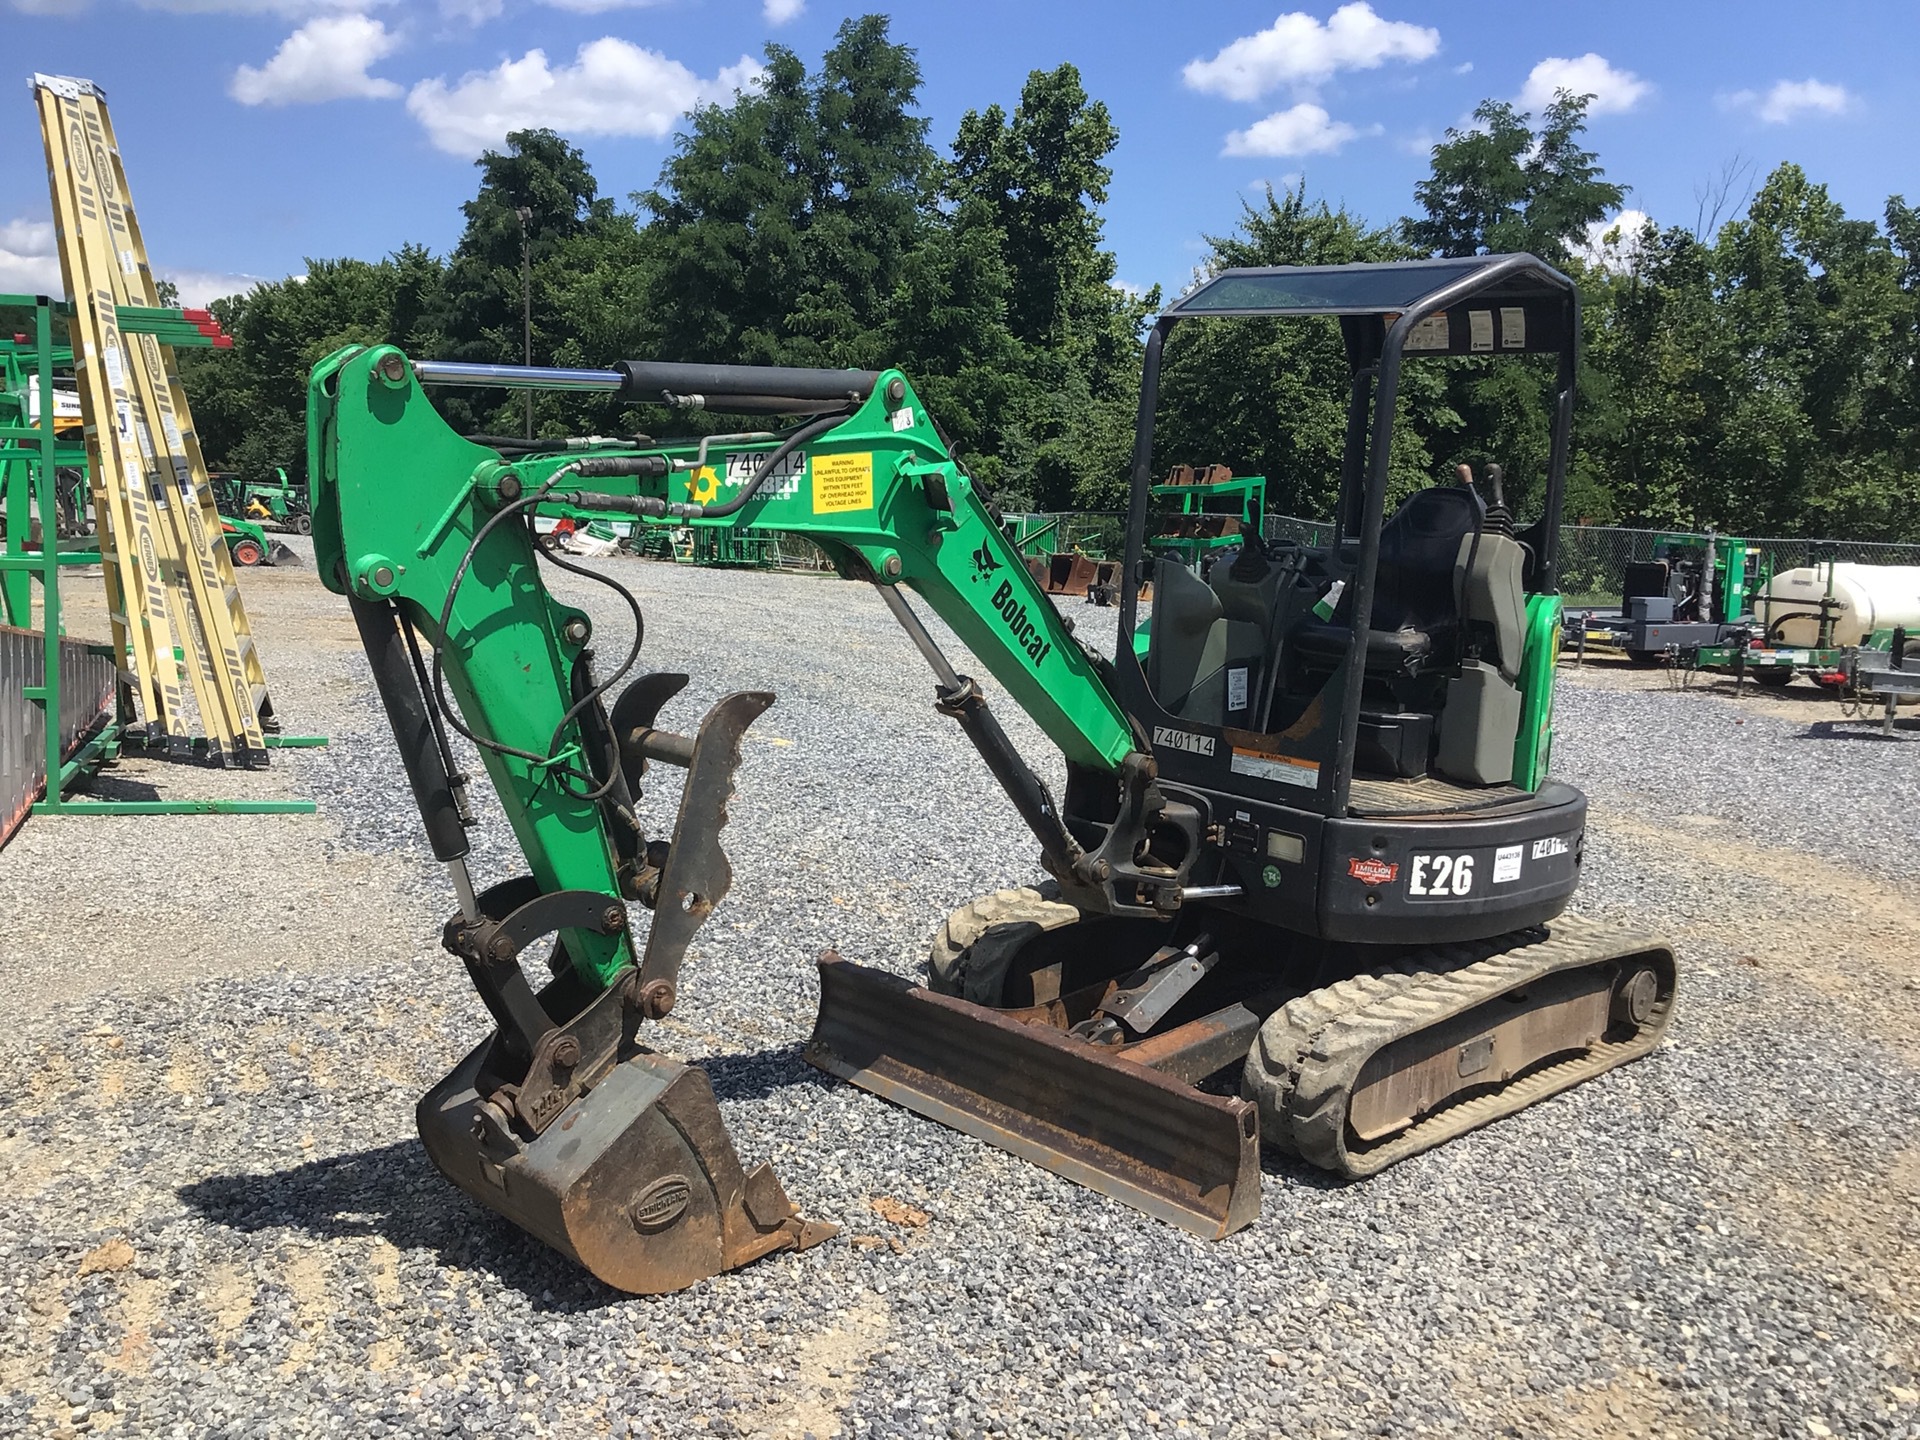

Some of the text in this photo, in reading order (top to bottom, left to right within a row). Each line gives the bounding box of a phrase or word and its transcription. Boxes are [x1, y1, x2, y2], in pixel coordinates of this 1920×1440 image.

[73, 134, 86, 171] WERNER
[97, 155, 111, 189] WERNER
[144, 339, 159, 374] WERNER
[726, 452, 805, 476] 74014
[828, 491, 854, 499] OVERHEAD
[191, 517, 206, 549] WERNER
[142, 536, 157, 573] WERNER
[991, 578, 1051, 668] Bobcat
[1156, 727, 1213, 755] 740114
[1360, 865, 1391, 875] MILLION
[1409, 855, 1475, 896] E26
